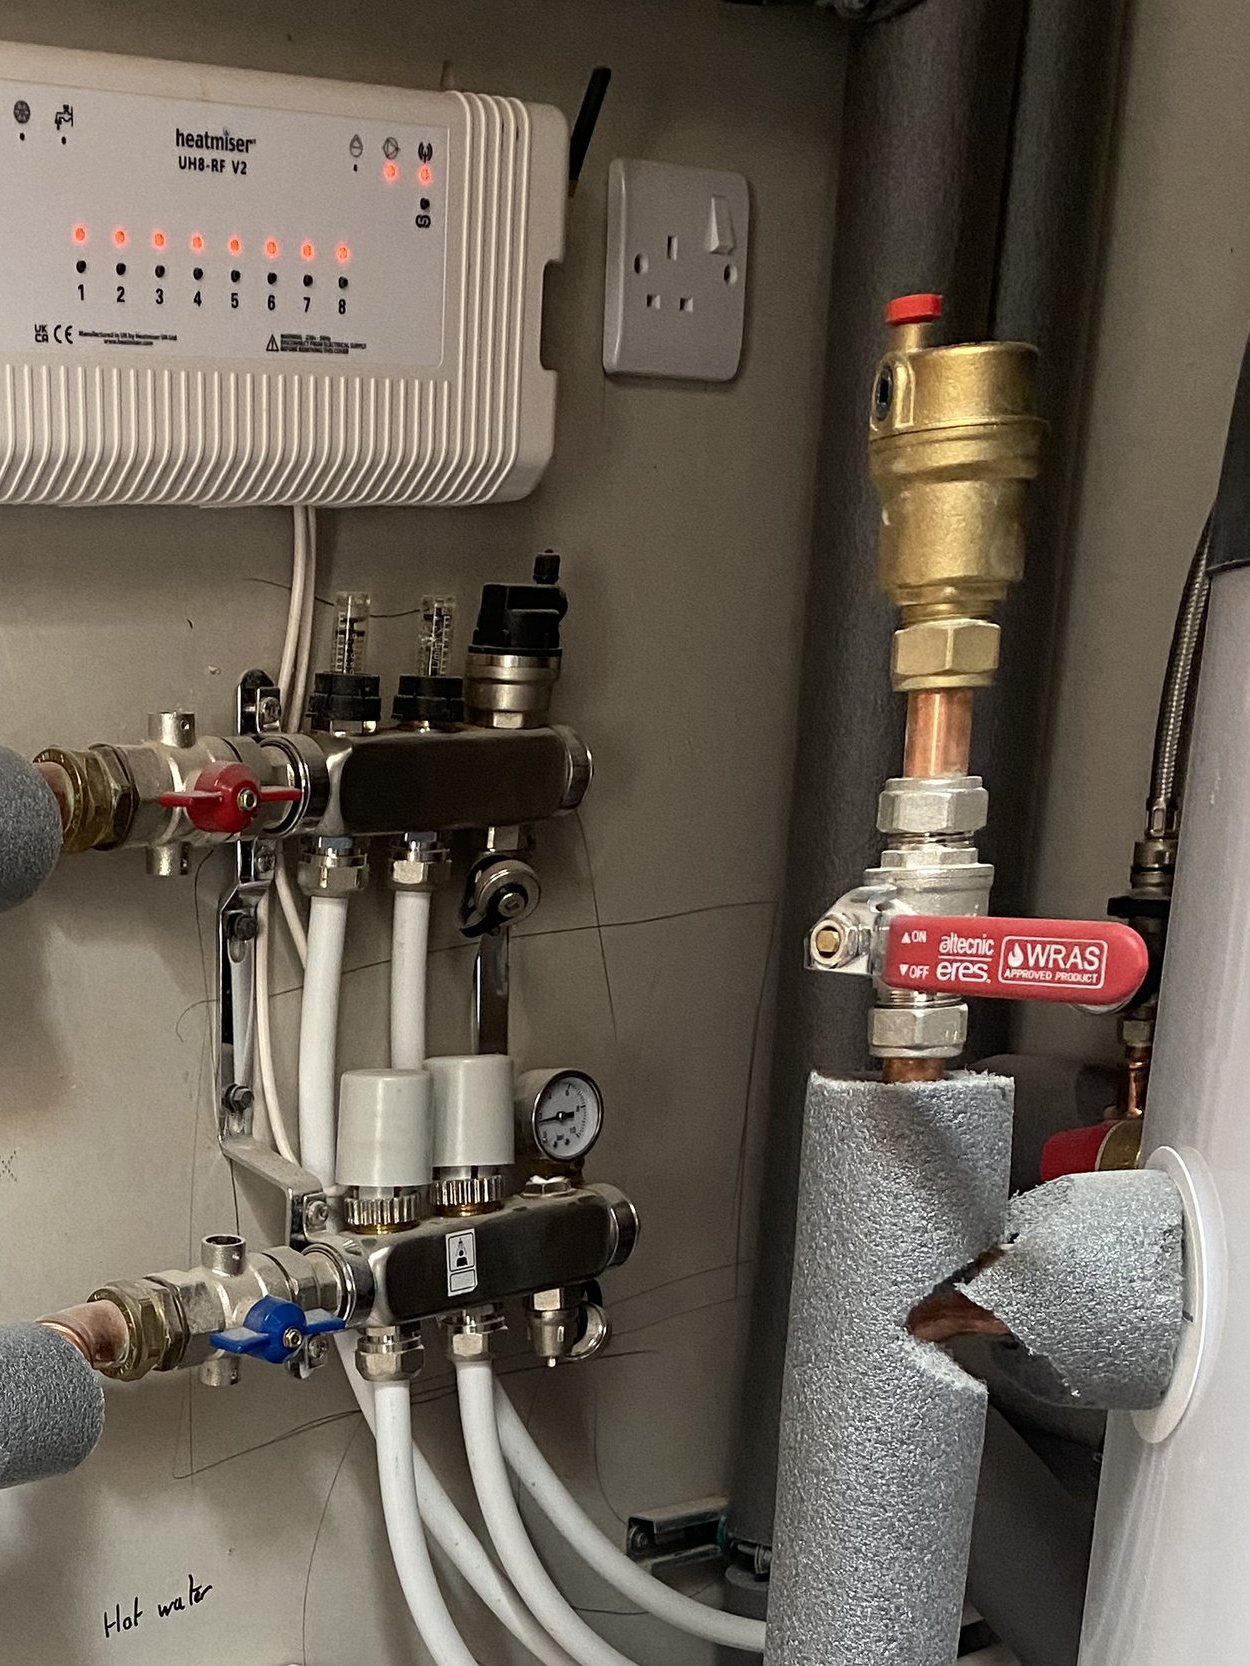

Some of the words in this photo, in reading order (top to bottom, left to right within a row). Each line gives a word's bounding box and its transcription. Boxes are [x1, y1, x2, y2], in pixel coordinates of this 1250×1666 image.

[175, 127, 250, 153] heatmiser
[178, 155, 226, 173] UH8-RF
[231, 160, 248, 175] V2
[77, 283, 85, 301] 1
[116, 286, 126, 303] 2
[155, 288, 164, 305] 3
[193, 290, 202, 307] 4
[230, 292, 240, 309] 5
[267, 294, 276, 311] 6
[302, 296, 311, 313] 7
[337, 298, 347, 315] 8
[911, 930, 927, 943] ON
[938, 931, 995, 956] altecnic
[1026, 942, 1101, 971] WRAS
[909, 964, 930, 980] OFF
[1003, 968, 1053, 981] APPROVED
[1054, 971, 1098, 984] PRODUCT
[102, 1596, 144, 1639] Hot
[157, 1573, 214, 1619] water
